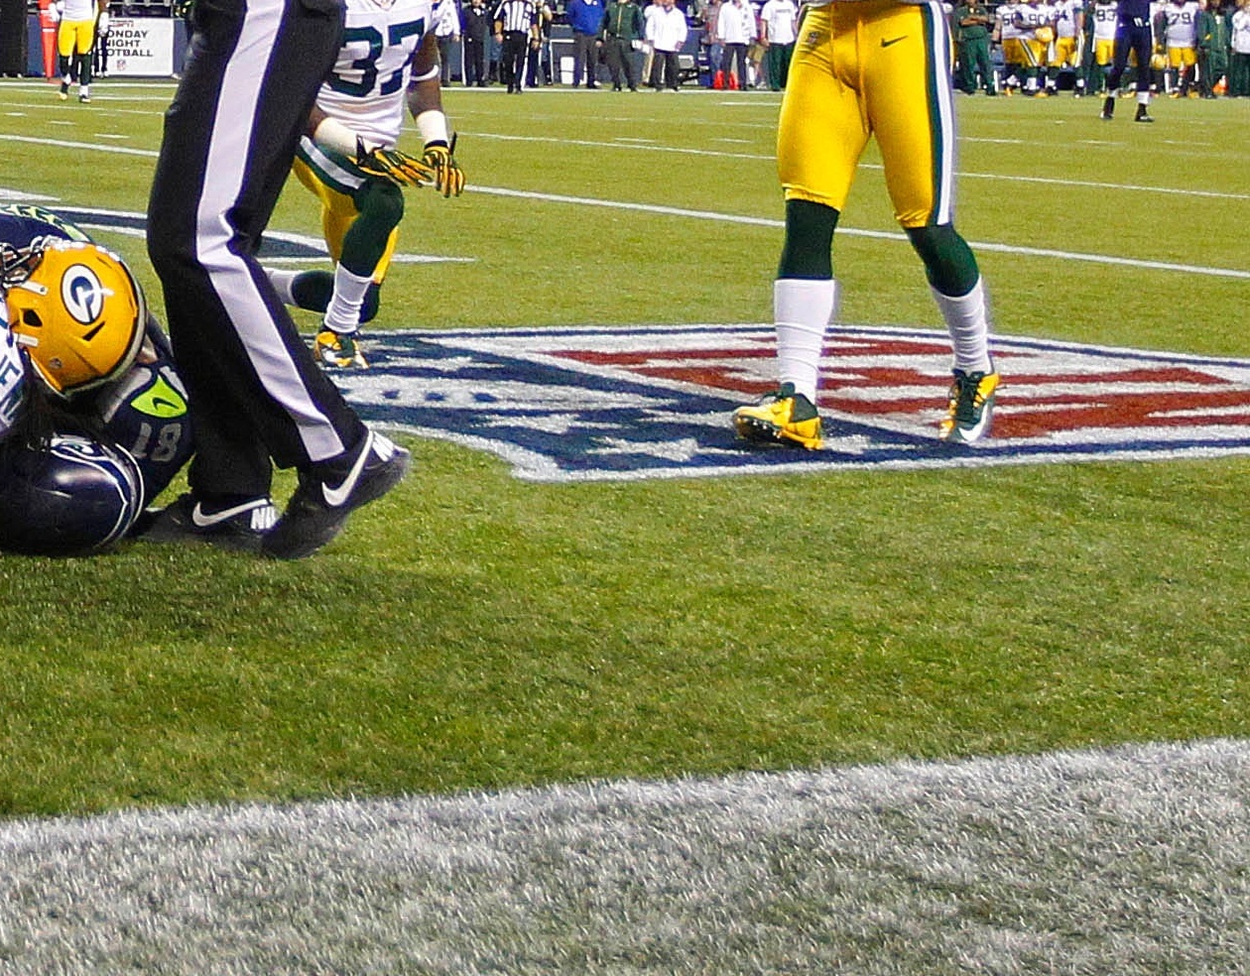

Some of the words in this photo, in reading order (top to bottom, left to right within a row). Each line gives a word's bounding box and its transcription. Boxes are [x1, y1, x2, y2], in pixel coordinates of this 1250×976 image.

[107, 30, 148, 38] ONDAY
[107, 48, 153, 57] OTBALL
[333, 17, 425, 97] 37
